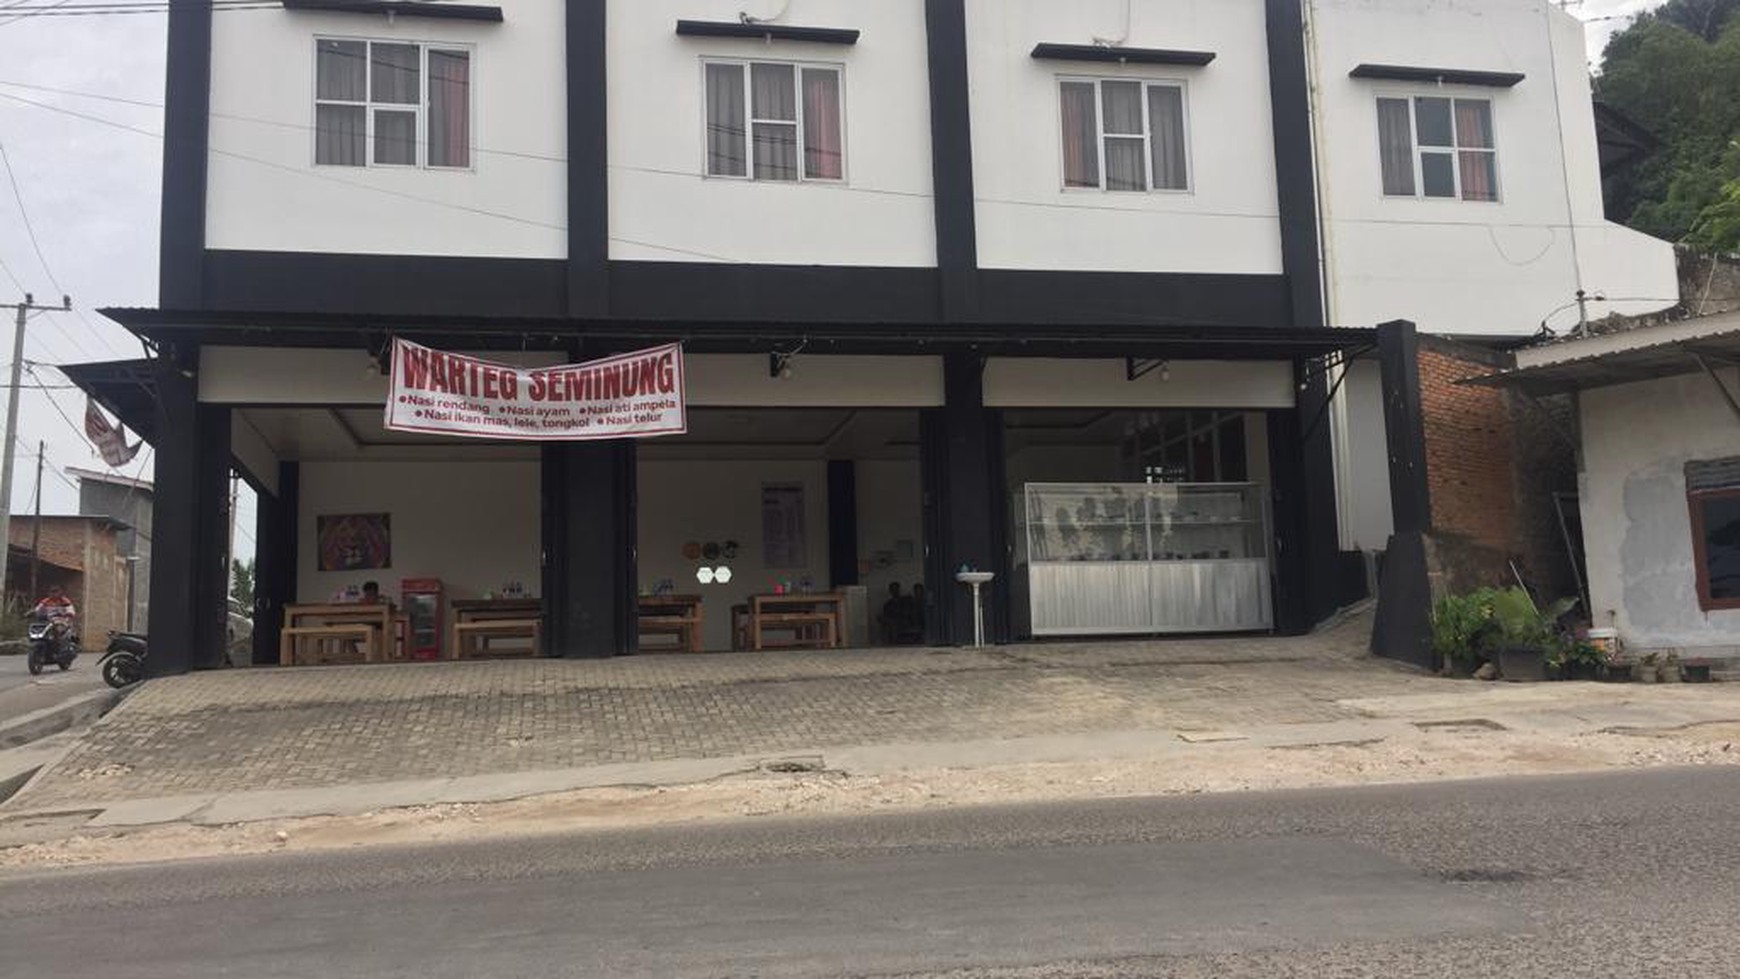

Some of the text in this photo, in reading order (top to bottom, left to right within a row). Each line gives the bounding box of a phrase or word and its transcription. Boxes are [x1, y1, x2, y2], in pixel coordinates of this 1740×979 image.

[402, 346, 674, 403] WARTEG SEMINUNG
[409, 395, 490, 415] Nasi rendang
[507, 406, 570, 417] Nasi ayam
[588, 399, 676, 415] Nasi ati ampela
[424, 409, 452, 421] Nasi
[454, 411, 481, 424] ikan
[542, 417, 590, 429] tongkol
[606, 412, 662, 425] Nasi telur
